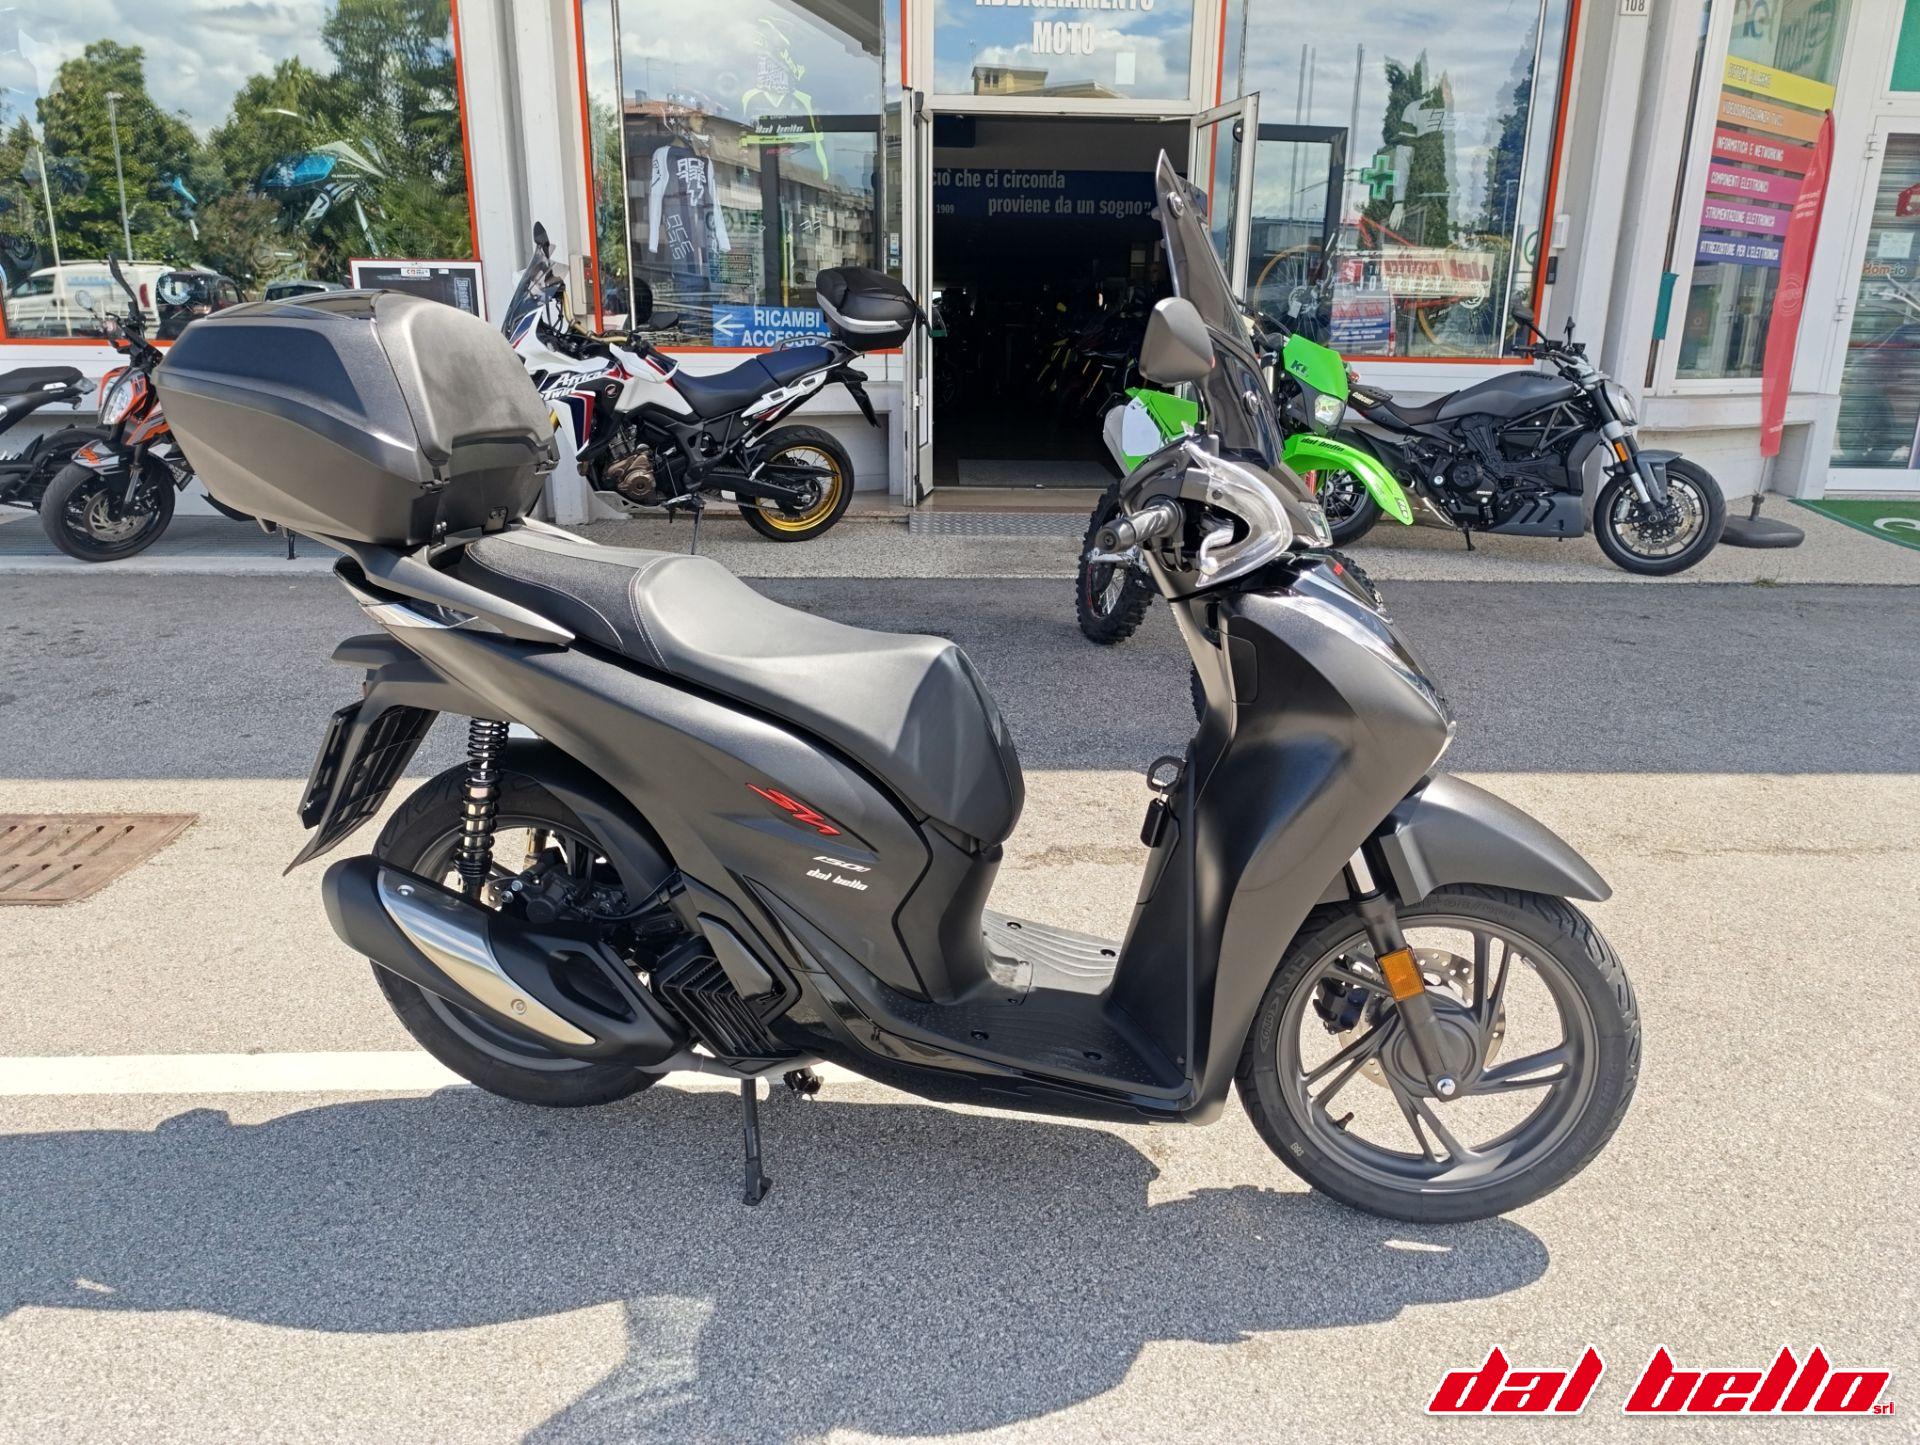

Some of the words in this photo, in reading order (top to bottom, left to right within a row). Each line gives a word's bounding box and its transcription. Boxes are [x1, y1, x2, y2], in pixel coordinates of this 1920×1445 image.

[1032, 20, 1096, 55] MOTO
[955, 170, 980, 188] che
[985, 170, 999, 188] ci
[1003, 171, 1066, 189] circonda
[935, 203, 955, 214] 1909
[988, 195, 1050, 216] proviene
[1055, 197, 1072, 214] da
[1077, 200, 1094, 215] un
[754, 310, 820, 328] RICAMBI
[806, 867, 832, 882] dal
[832, 875, 869, 892] bello
